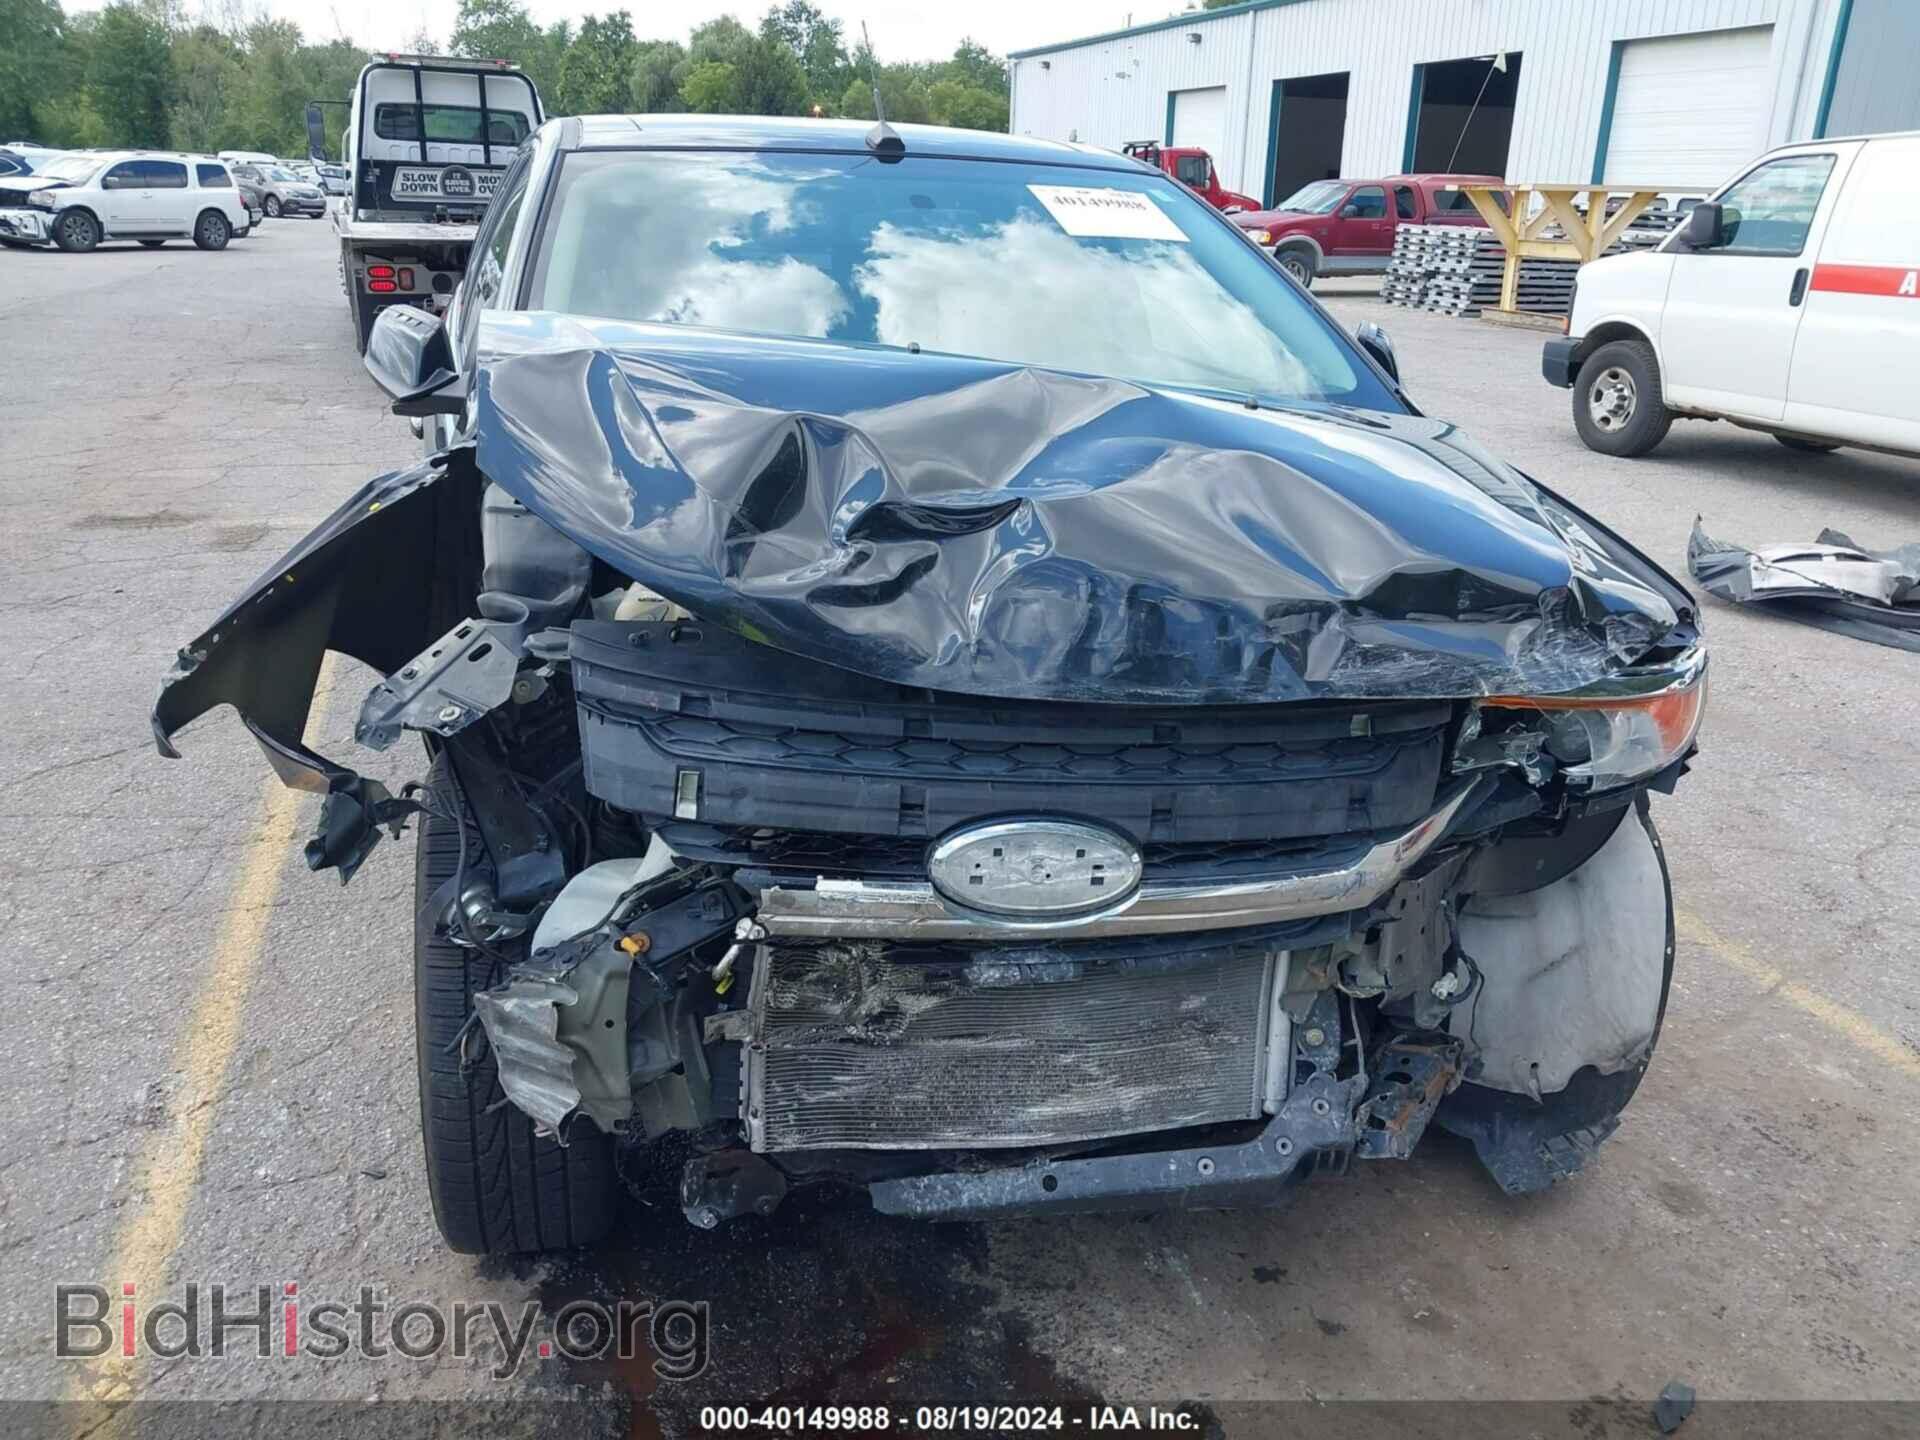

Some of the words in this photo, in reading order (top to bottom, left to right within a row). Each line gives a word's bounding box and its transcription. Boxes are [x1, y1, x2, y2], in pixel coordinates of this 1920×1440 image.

[402, 173, 438, 183] SLOW
[478, 175, 500, 185] MO
[400, 182, 438, 192] DOWN
[478, 185, 495, 194] OV
